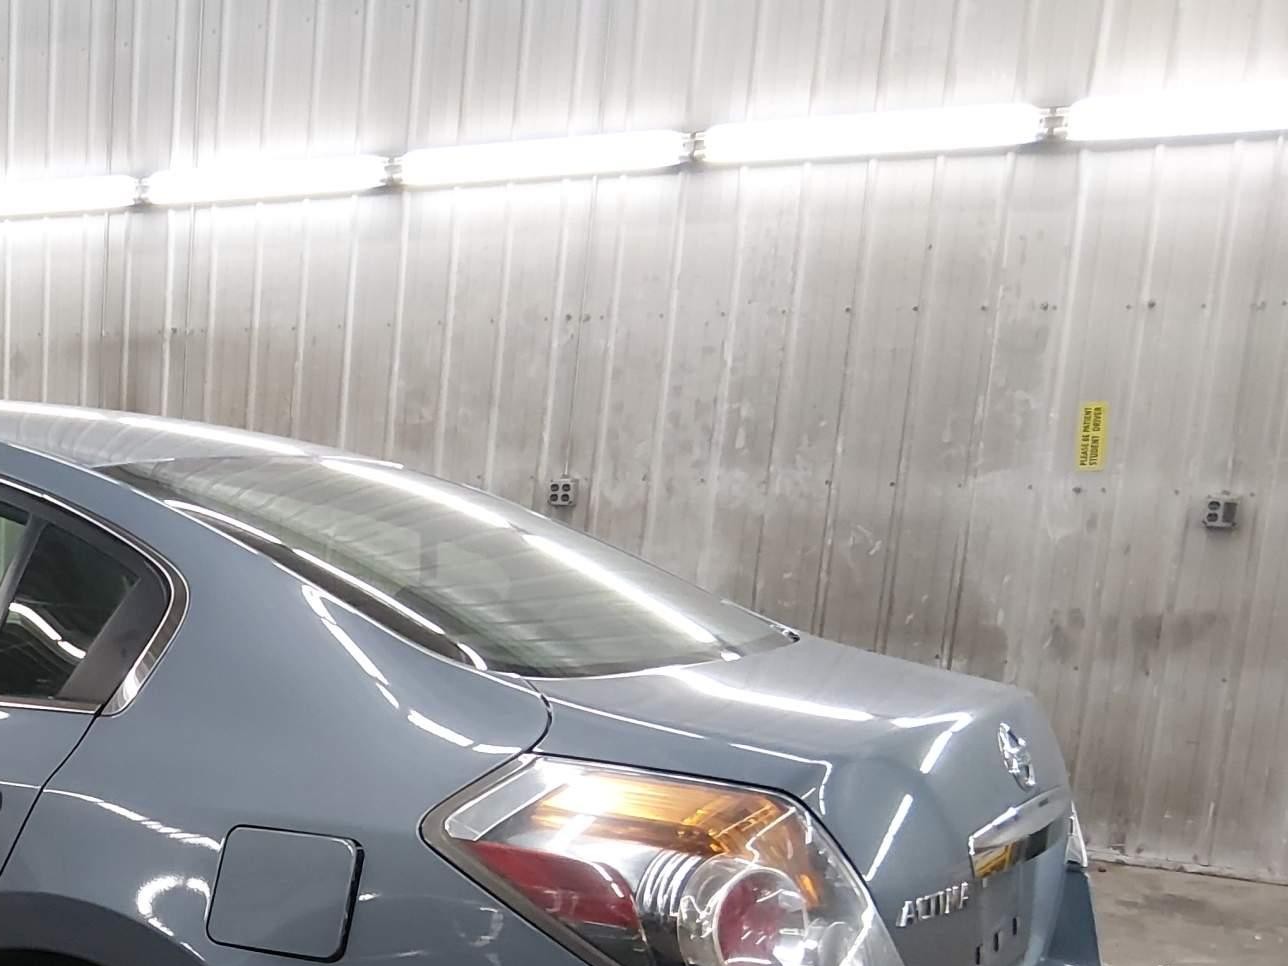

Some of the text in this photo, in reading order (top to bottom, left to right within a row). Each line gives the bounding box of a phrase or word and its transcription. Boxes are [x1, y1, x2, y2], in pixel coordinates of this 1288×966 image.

[1083, 407, 1092, 432] PATIENT
[1089, 407, 1102, 465] STUDENT DRIVER
[1079, 443, 1089, 466] PLEASE
